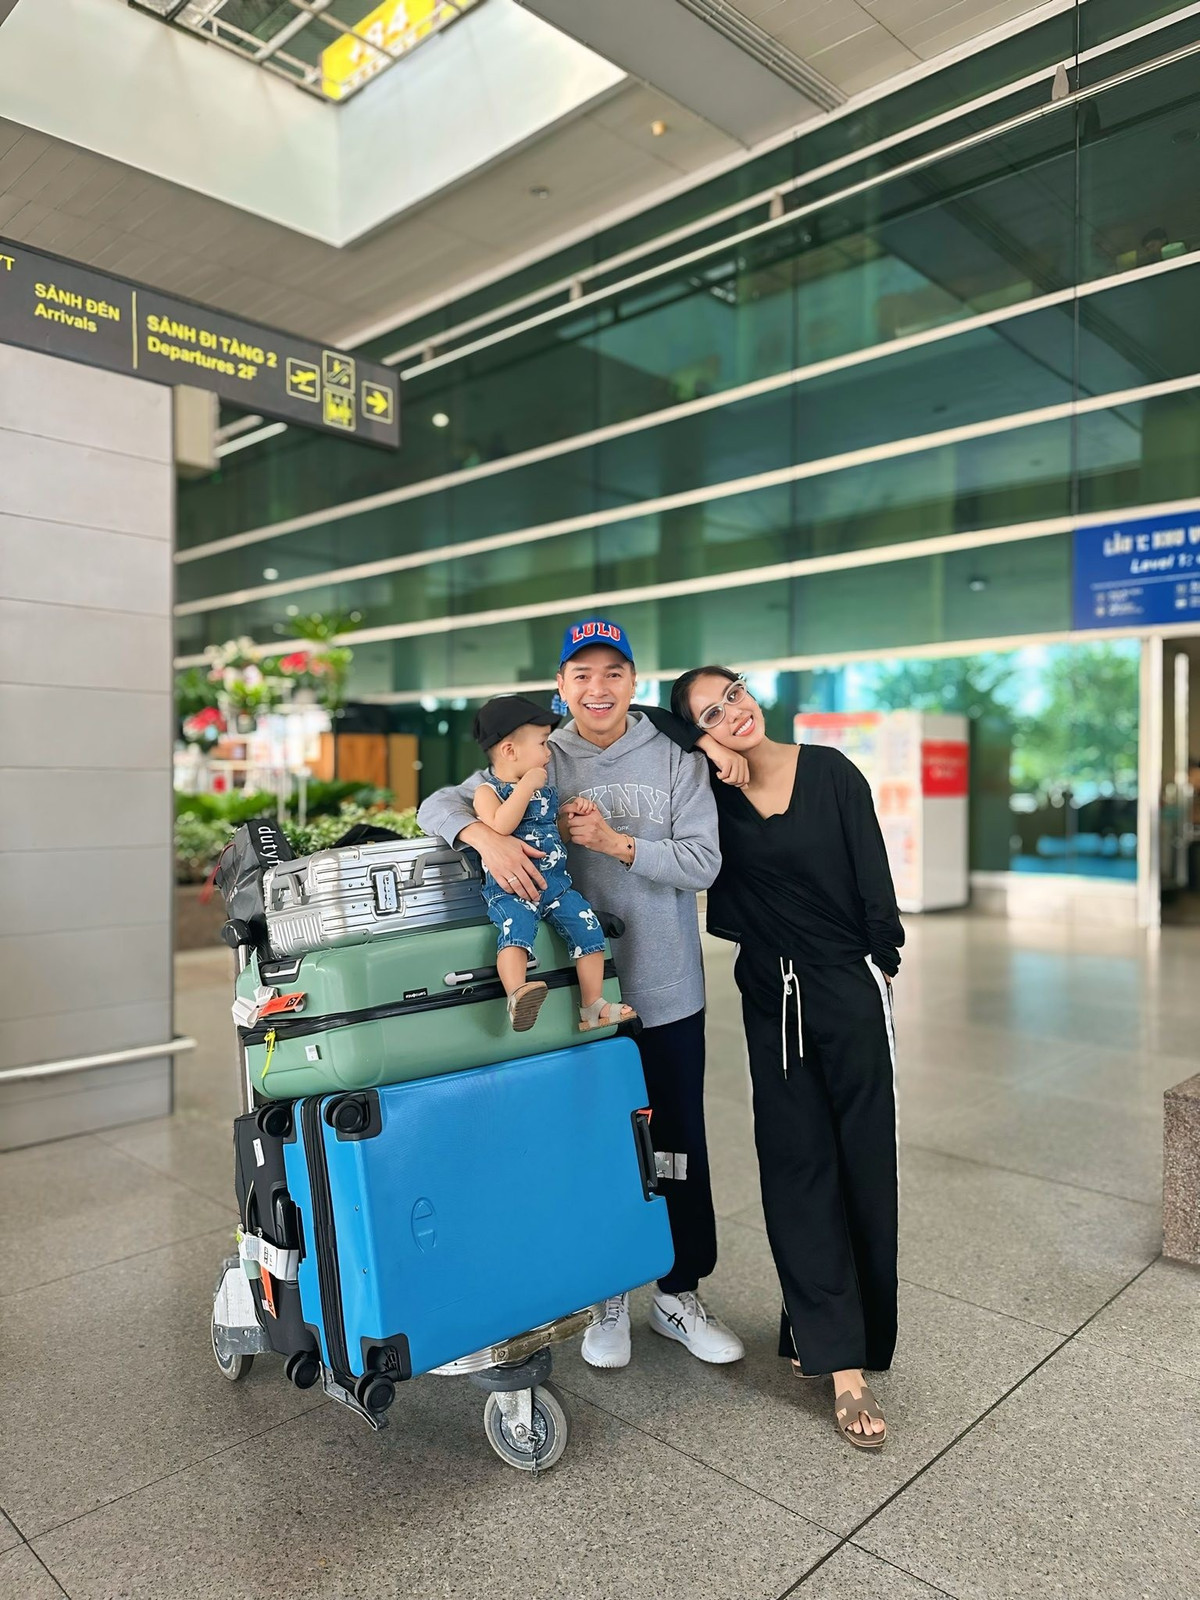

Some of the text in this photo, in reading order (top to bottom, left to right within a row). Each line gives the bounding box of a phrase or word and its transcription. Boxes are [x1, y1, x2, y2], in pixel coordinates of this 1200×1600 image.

[34, 303, 97, 332] Arrivals
[147, 335, 257, 380] Departures 2F
[266, 352, 278, 368] 2
[572, 621, 621, 644] LULU
[560, 783, 669, 824] KNY
